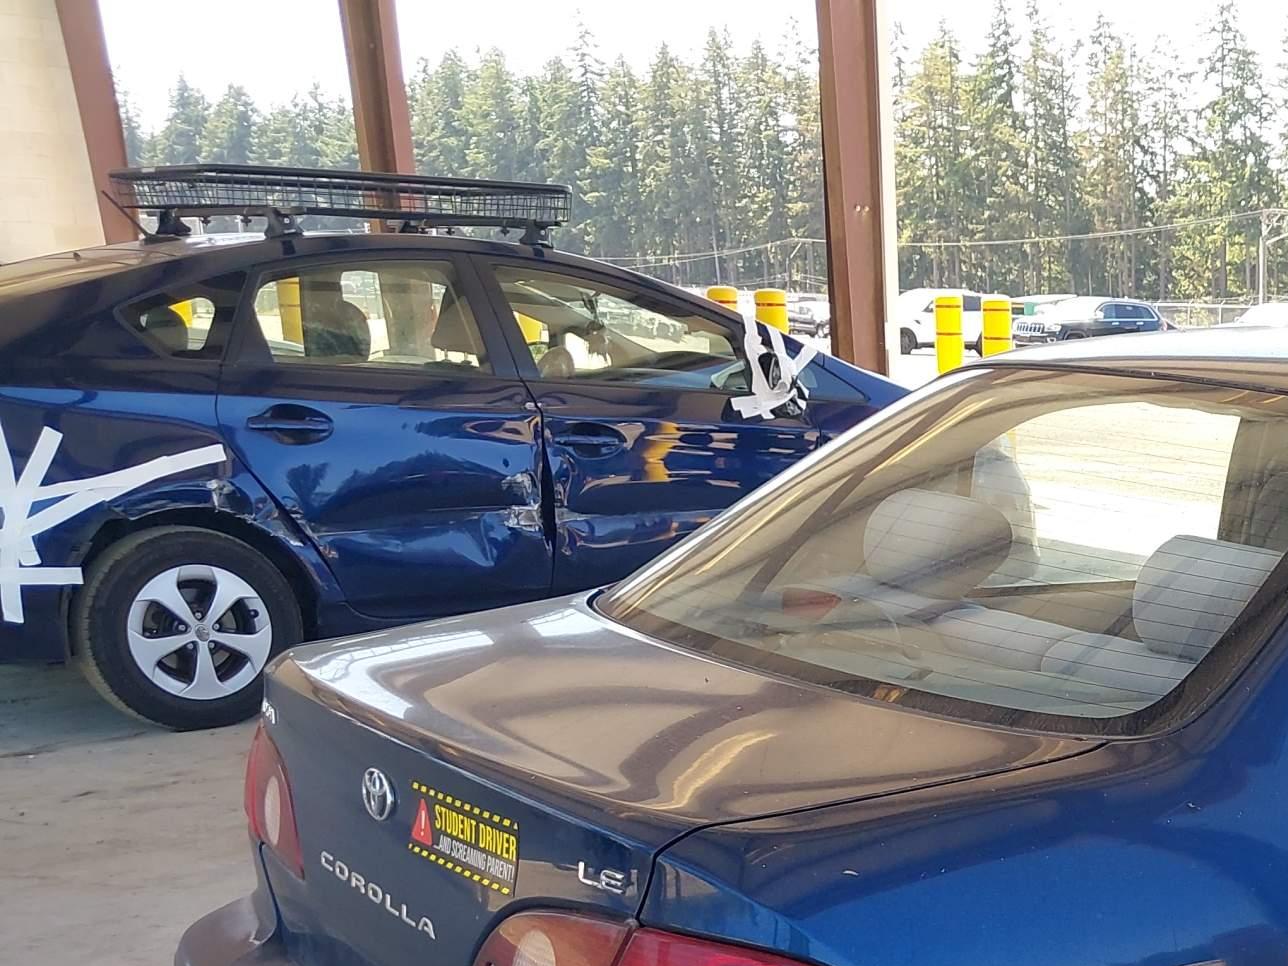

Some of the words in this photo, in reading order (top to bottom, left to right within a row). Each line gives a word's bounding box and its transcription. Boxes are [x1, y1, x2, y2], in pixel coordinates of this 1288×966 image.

[434, 804, 477, 844] STUDENT
[478, 822, 517, 862] DRIVER
[450, 839, 488, 871] SCREAMING
[486, 854, 515, 883] PARENT!
[578, 860, 625, 895] LE
[320, 850, 436, 941] COROLLA
